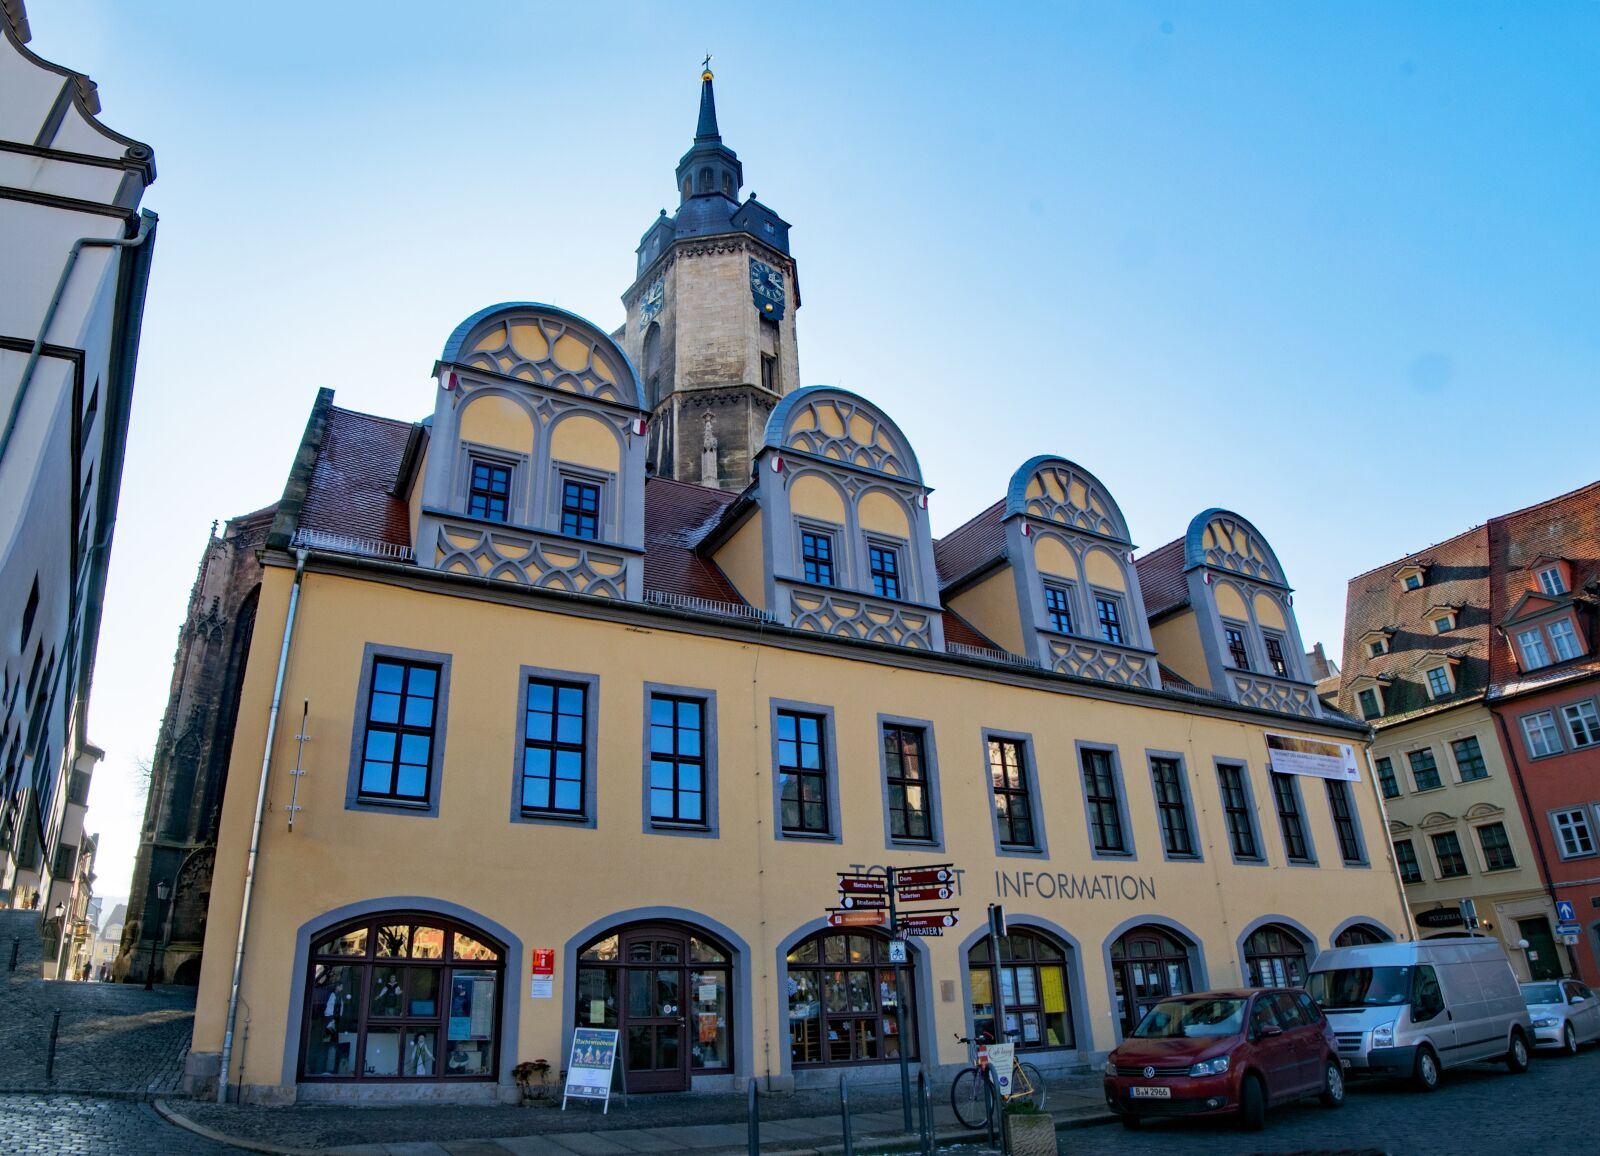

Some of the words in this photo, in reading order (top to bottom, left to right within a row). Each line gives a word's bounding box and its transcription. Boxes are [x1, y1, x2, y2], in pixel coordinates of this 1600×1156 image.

[995, 870, 1156, 900] INFORMATION
[1428, 913, 1460, 921] PIZZERIA
[909, 927, 938, 936] THEATER
[1150, 1088, 1168, 1096] 2966
